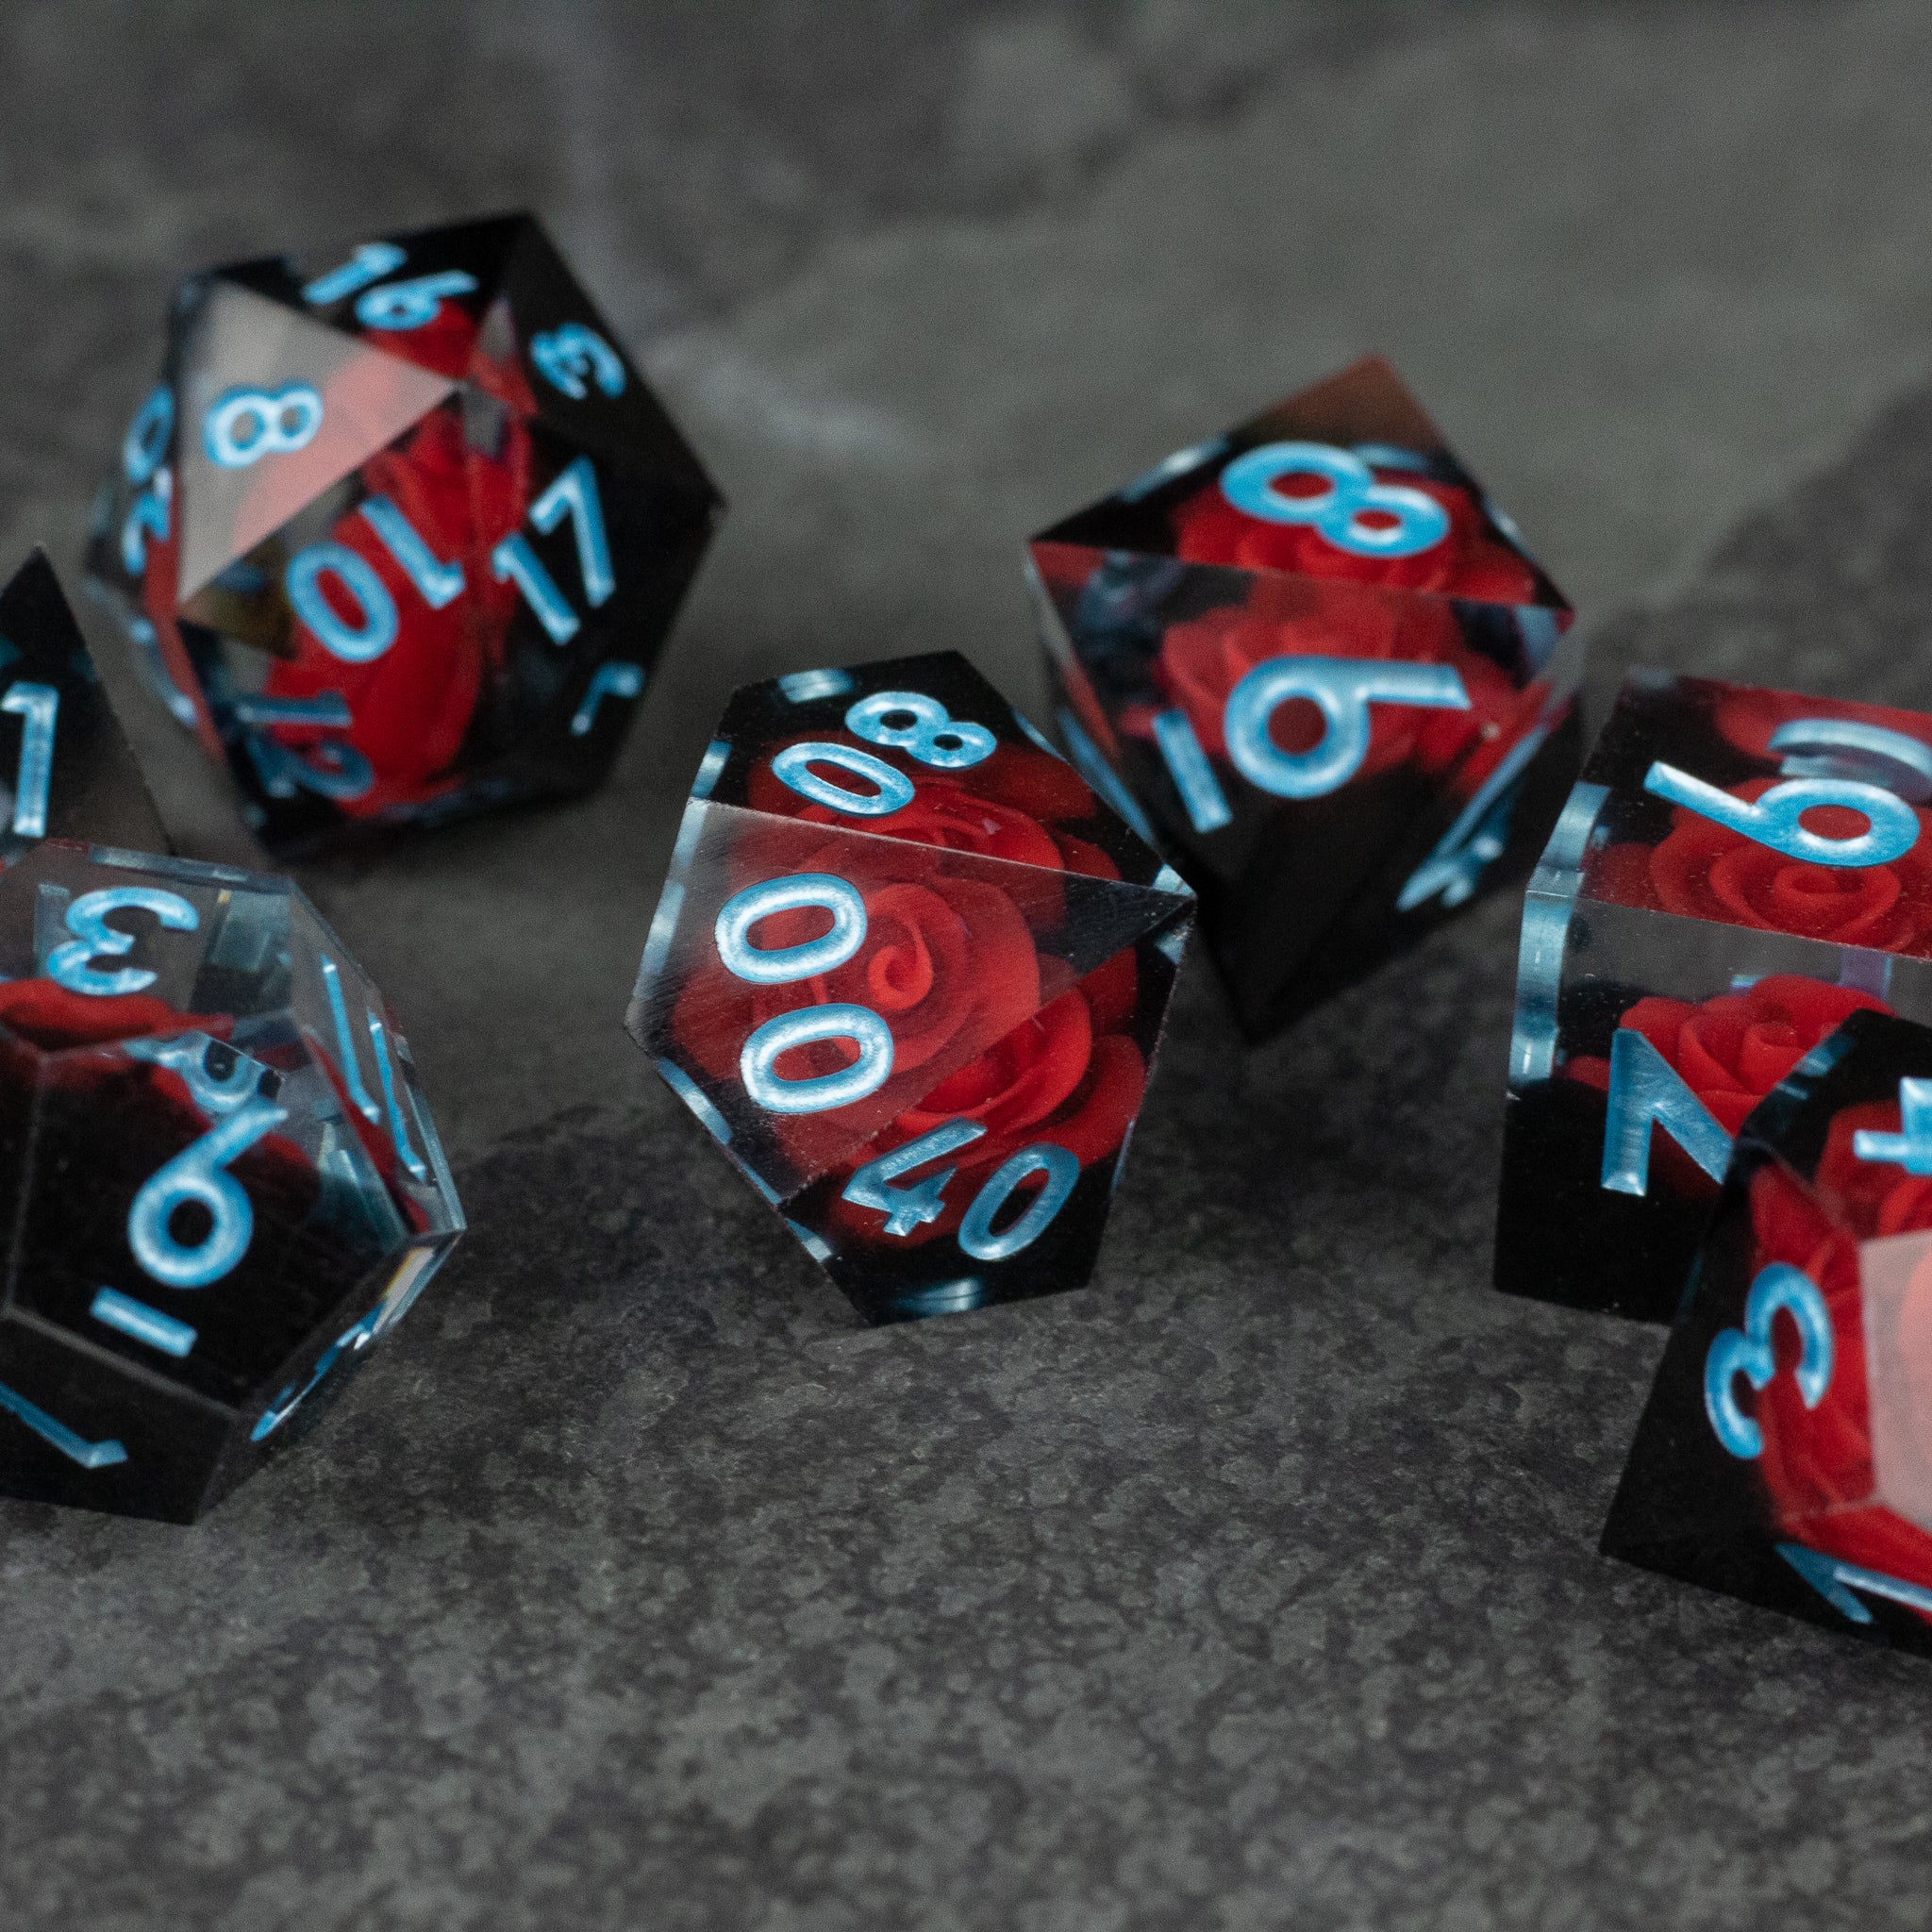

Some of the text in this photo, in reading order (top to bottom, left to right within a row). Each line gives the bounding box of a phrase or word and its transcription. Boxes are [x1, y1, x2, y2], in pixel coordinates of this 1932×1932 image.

[303, 242, 478, 330] 16
[203, 381, 323, 470] 8
[491, 457, 615, 645] 17
[1220, 441, 1450, 558] 8
[286, 493, 465, 662] 10
[772, 691, 997, 817] 80
[48, 885, 200, 996] 3
[715, 873, 894, 1114] 00
[841, 1117, 1081, 1261] 40
[1705, 1262, 1835, 1459] 3
